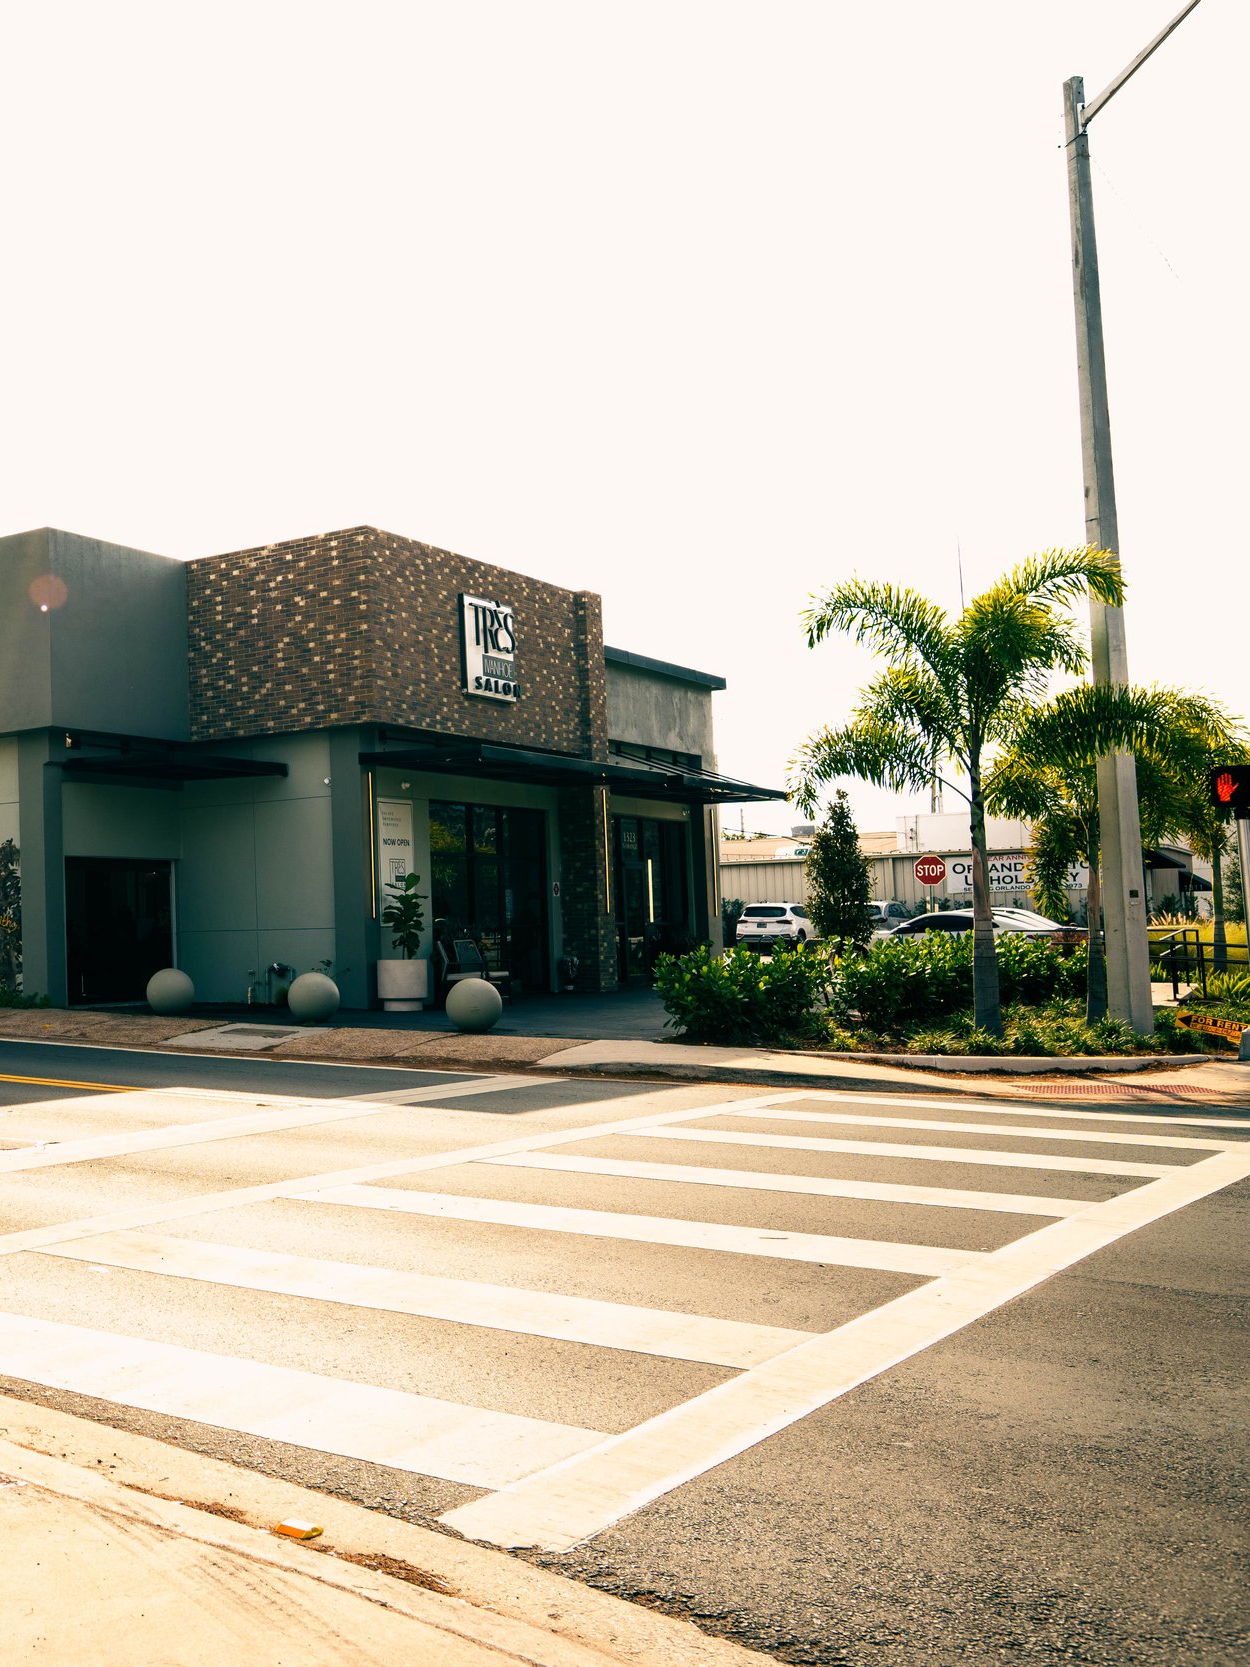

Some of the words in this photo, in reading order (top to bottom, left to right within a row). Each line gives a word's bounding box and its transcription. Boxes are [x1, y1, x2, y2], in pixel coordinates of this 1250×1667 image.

[484, 658, 513, 679] IVANHOE
[474, 676, 522, 698] SALON
[382, 838, 397, 846] NOW
[397, 838, 410, 847] OPEN
[916, 864, 945, 877] STOP
[1191, 1015, 1213, 1026] FOR
[1216, 1020, 1249, 1031] RENT
